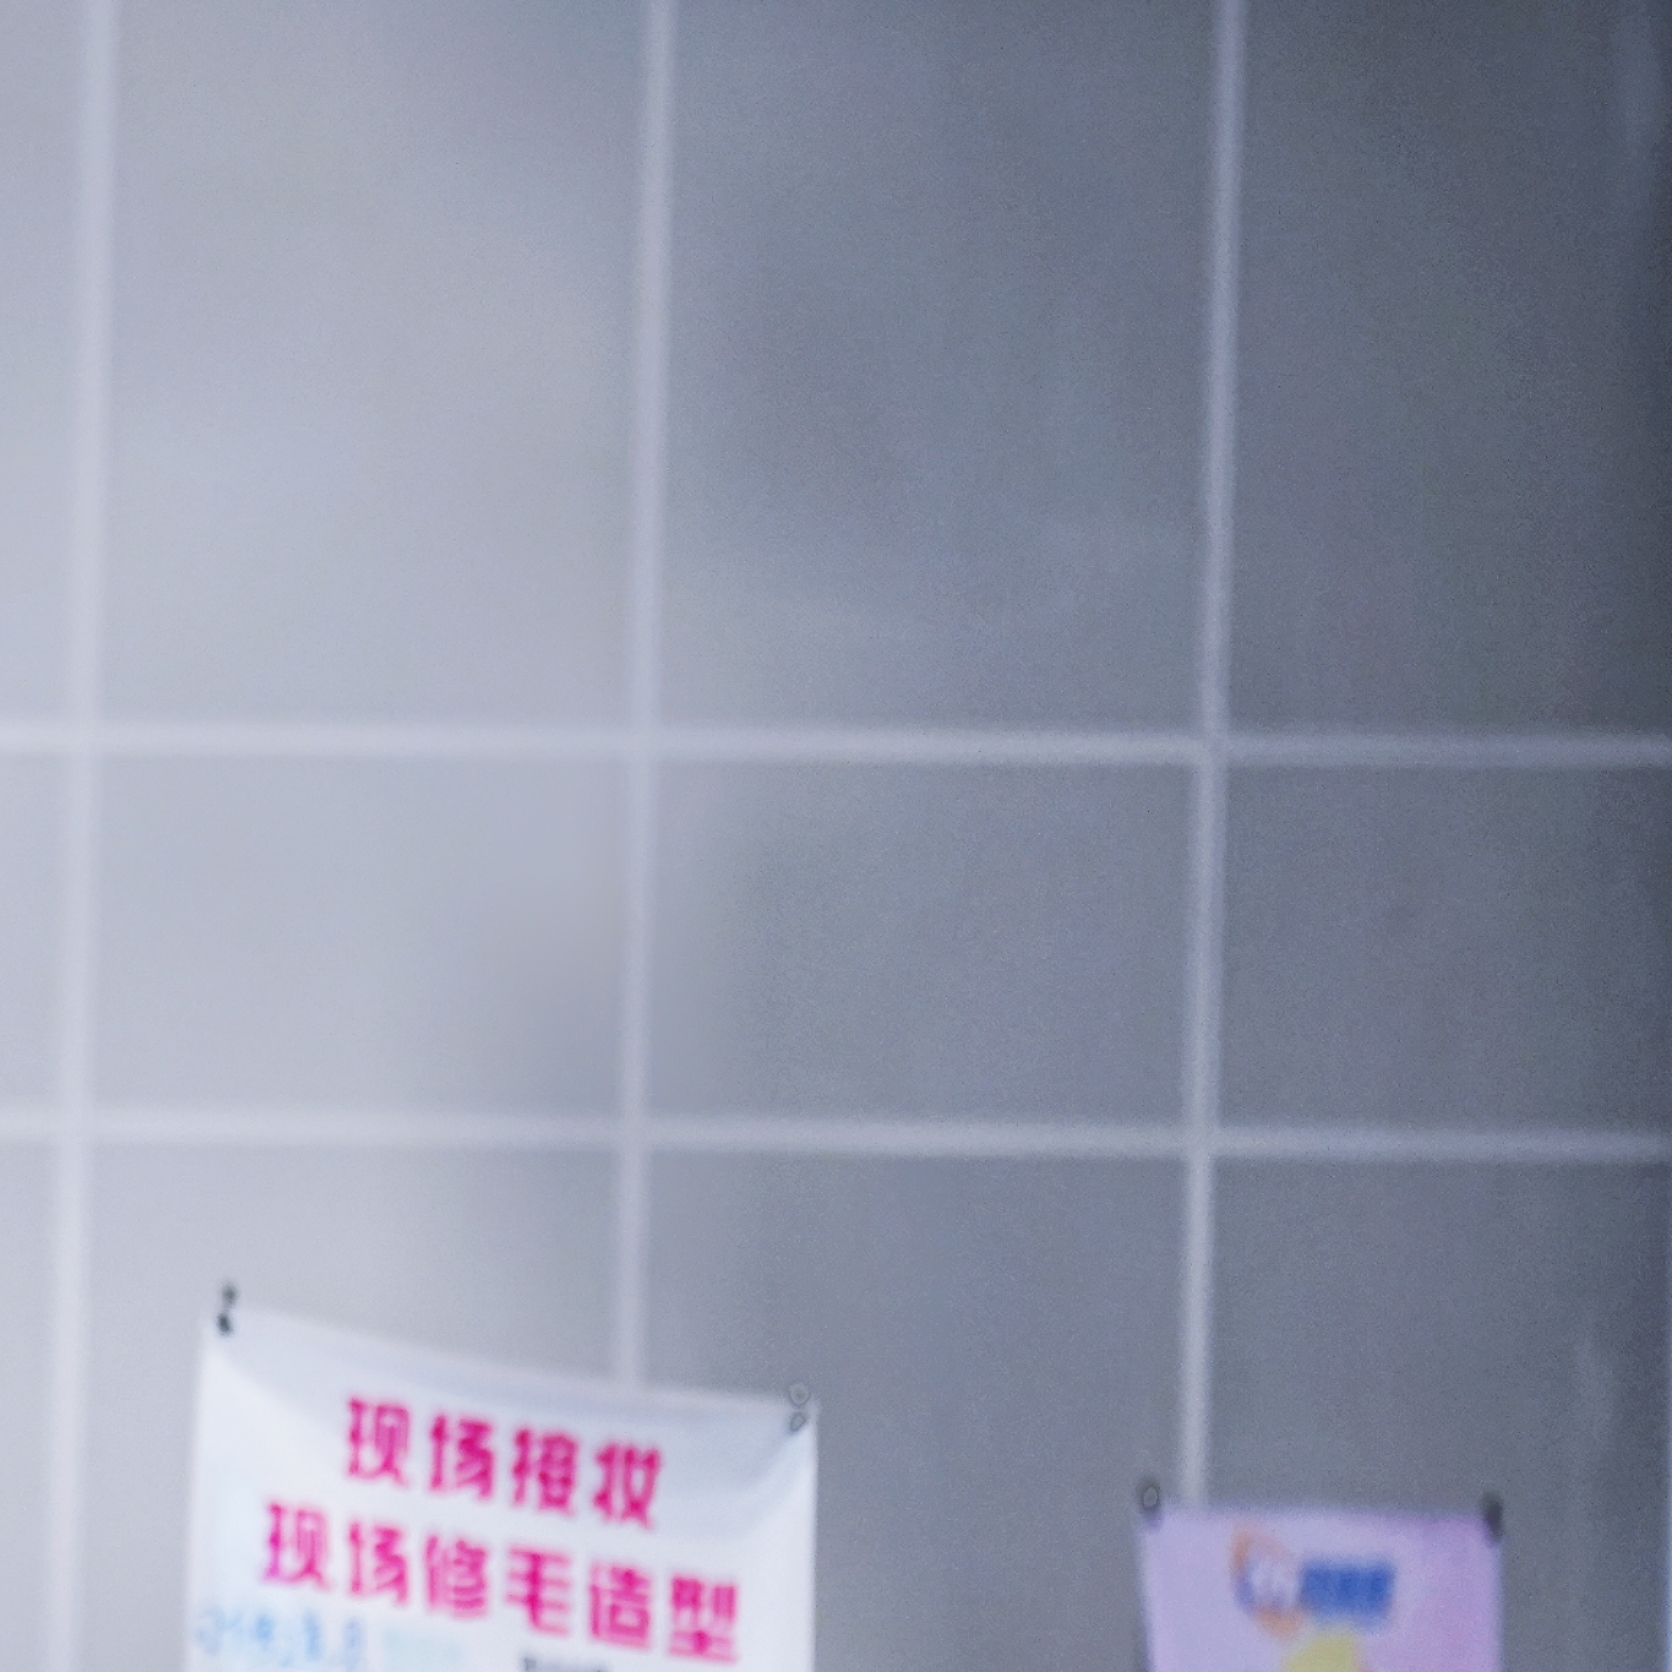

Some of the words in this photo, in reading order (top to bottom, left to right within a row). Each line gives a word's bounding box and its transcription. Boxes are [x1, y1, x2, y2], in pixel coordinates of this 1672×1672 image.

[348, 1395, 662, 1530] 现场接妆
[262, 1499, 739, 1664] 现场修毛造型
